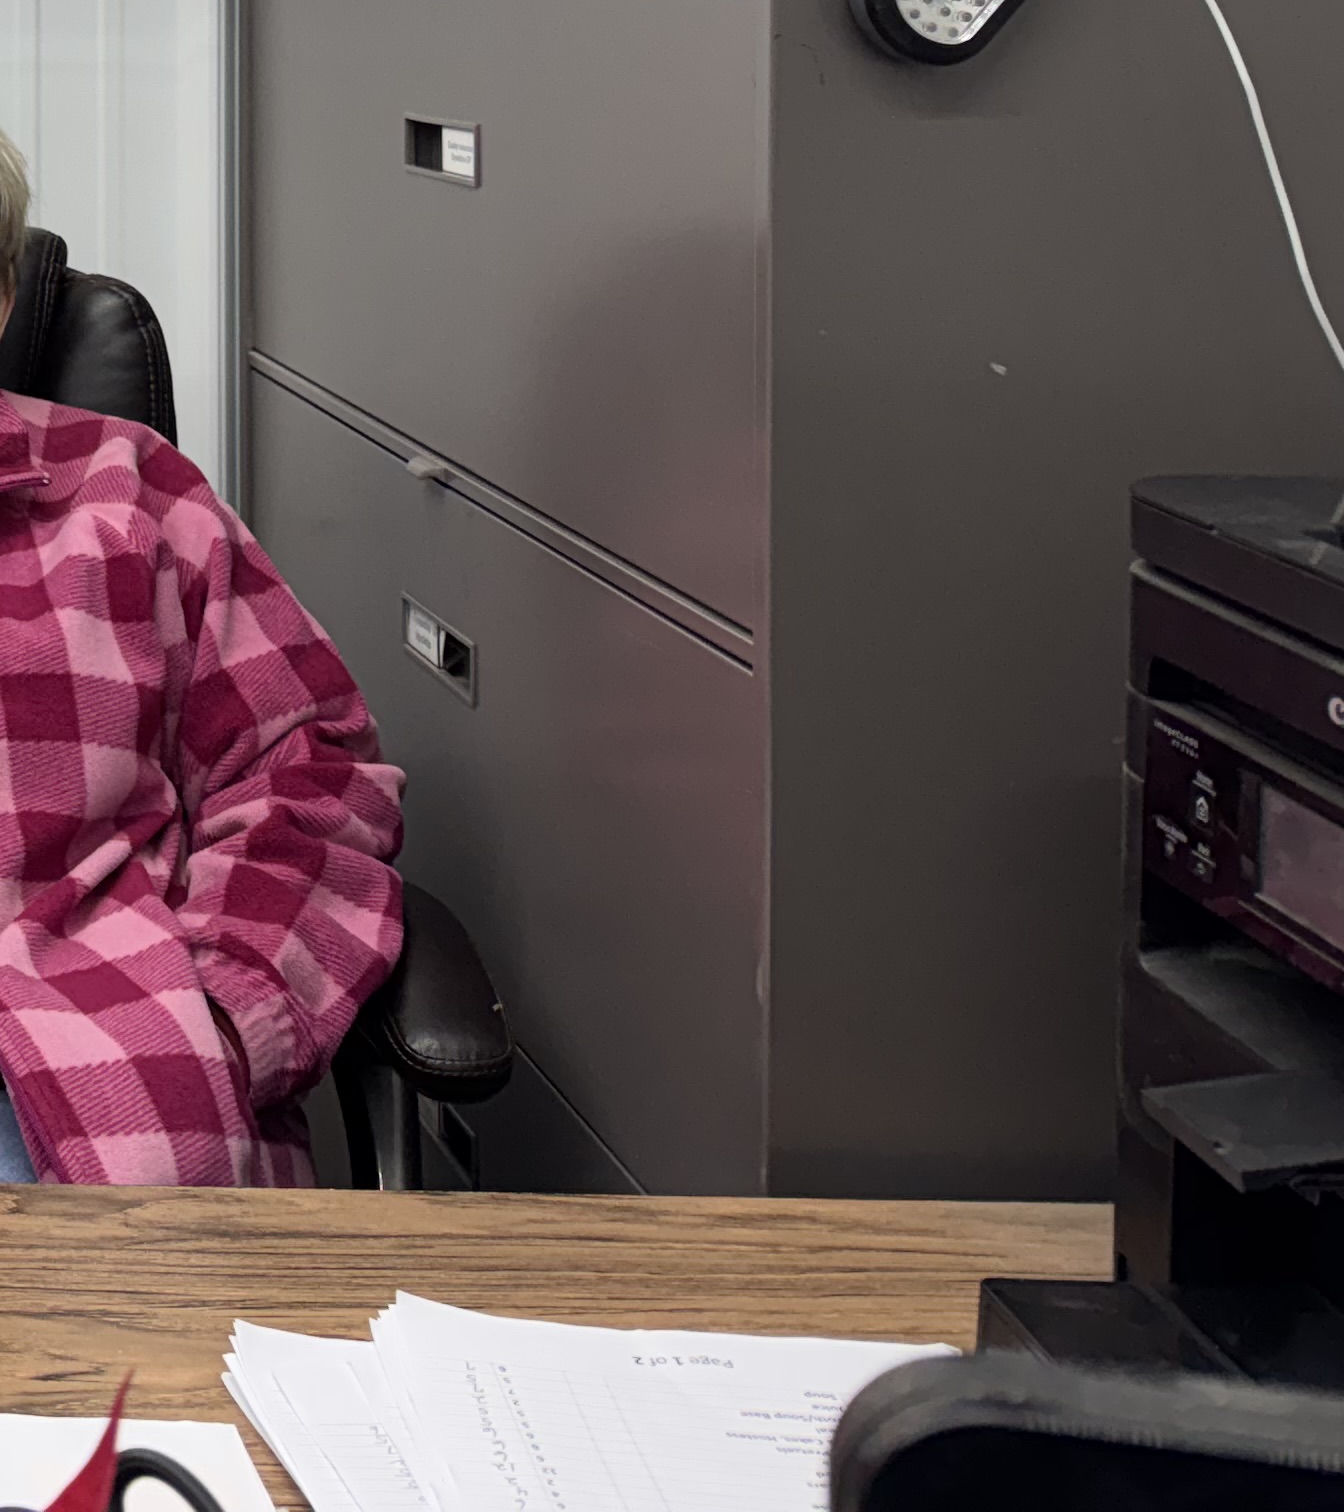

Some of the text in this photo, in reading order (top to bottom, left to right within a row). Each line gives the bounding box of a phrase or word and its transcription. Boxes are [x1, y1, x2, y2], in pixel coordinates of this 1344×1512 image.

[631, 1355, 736, 1370] Page 1 of 2
